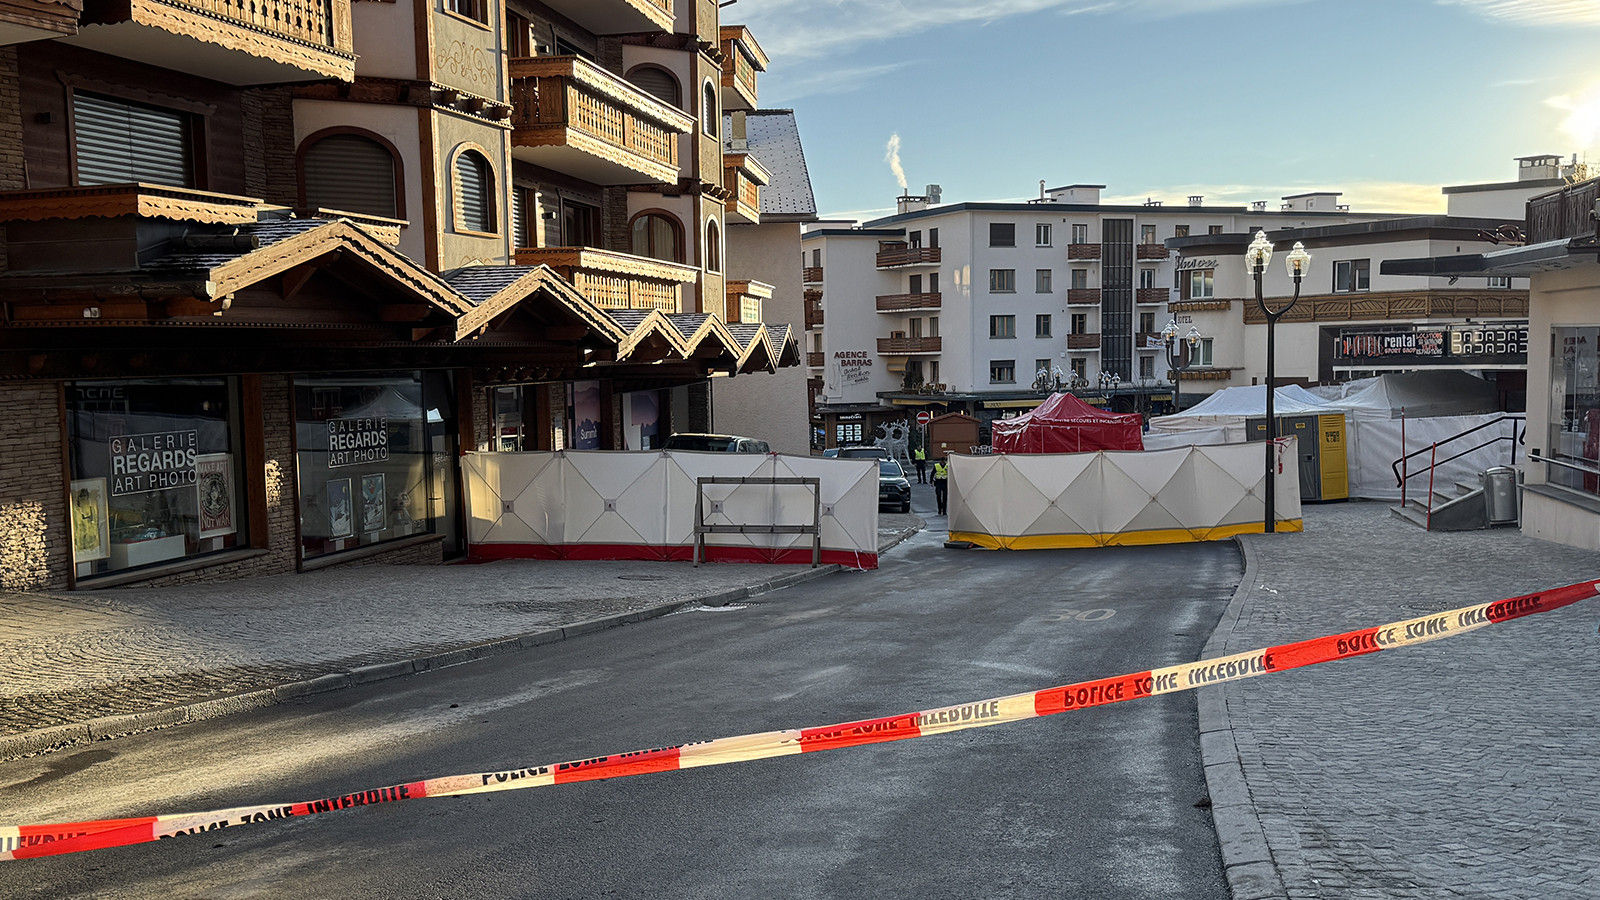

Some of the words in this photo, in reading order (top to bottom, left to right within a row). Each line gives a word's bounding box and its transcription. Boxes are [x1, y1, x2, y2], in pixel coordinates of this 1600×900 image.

[1384, 333, 1416, 348] rental
[834, 351, 868, 359] AGENCE
[841, 359, 873, 367] BARRAS
[329, 417, 387, 433] GALERIE
[580, 425, 599, 440] Summit
[112, 432, 195, 454] GALERIE
[330, 430, 388, 451] REGARDS
[113, 447, 198, 475] REGARDS
[331, 451, 350, 466] ART
[355, 446, 388, 462] PHOTO
[114, 475, 143, 493] ART
[149, 469, 197, 488] PHOTO
[307, 785, 411, 815] INTERDITE
